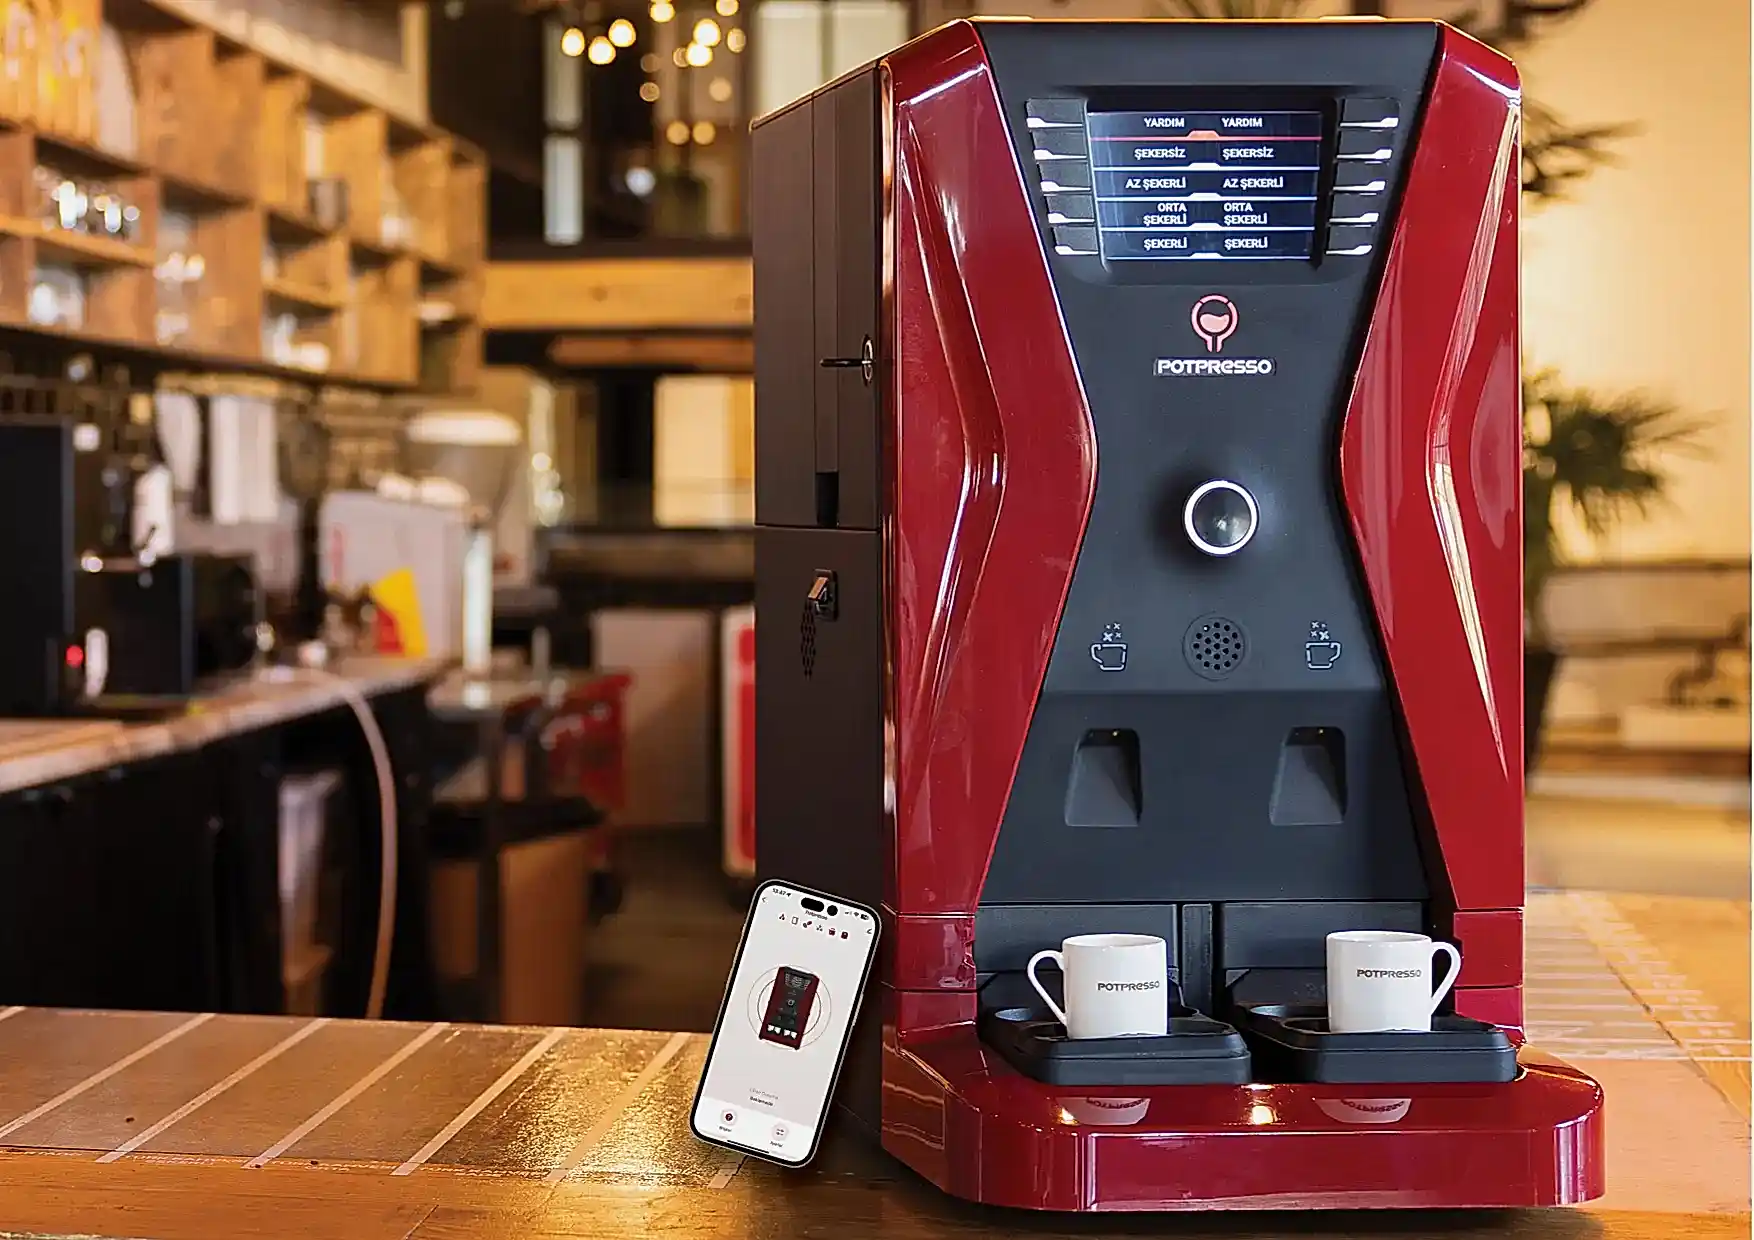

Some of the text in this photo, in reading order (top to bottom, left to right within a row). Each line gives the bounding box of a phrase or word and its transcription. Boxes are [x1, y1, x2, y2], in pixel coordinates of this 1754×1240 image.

[1144, 117, 1185, 128] YARDIM
[1221, 117, 1263, 128] YARDIM
[1134, 146, 1186, 160] ŞEKERSİZ
[1222, 146, 1274, 160] ŞEKERSİZ
[1125, 176, 1187, 190] AZ ŞEKERLİ
[1223, 176, 1284, 190] AZ ŞEKERLİ
[1157, 203, 1187, 213] ORTA
[1223, 203, 1253, 213] ORTA
[1143, 213, 1187, 226] ŞEKERLİ
[1223, 213, 1268, 226] ŞEKERLİ
[1143, 237, 1188, 250] ŞEKERLİ
[1224, 237, 1268, 250] ŞEKERLİ
